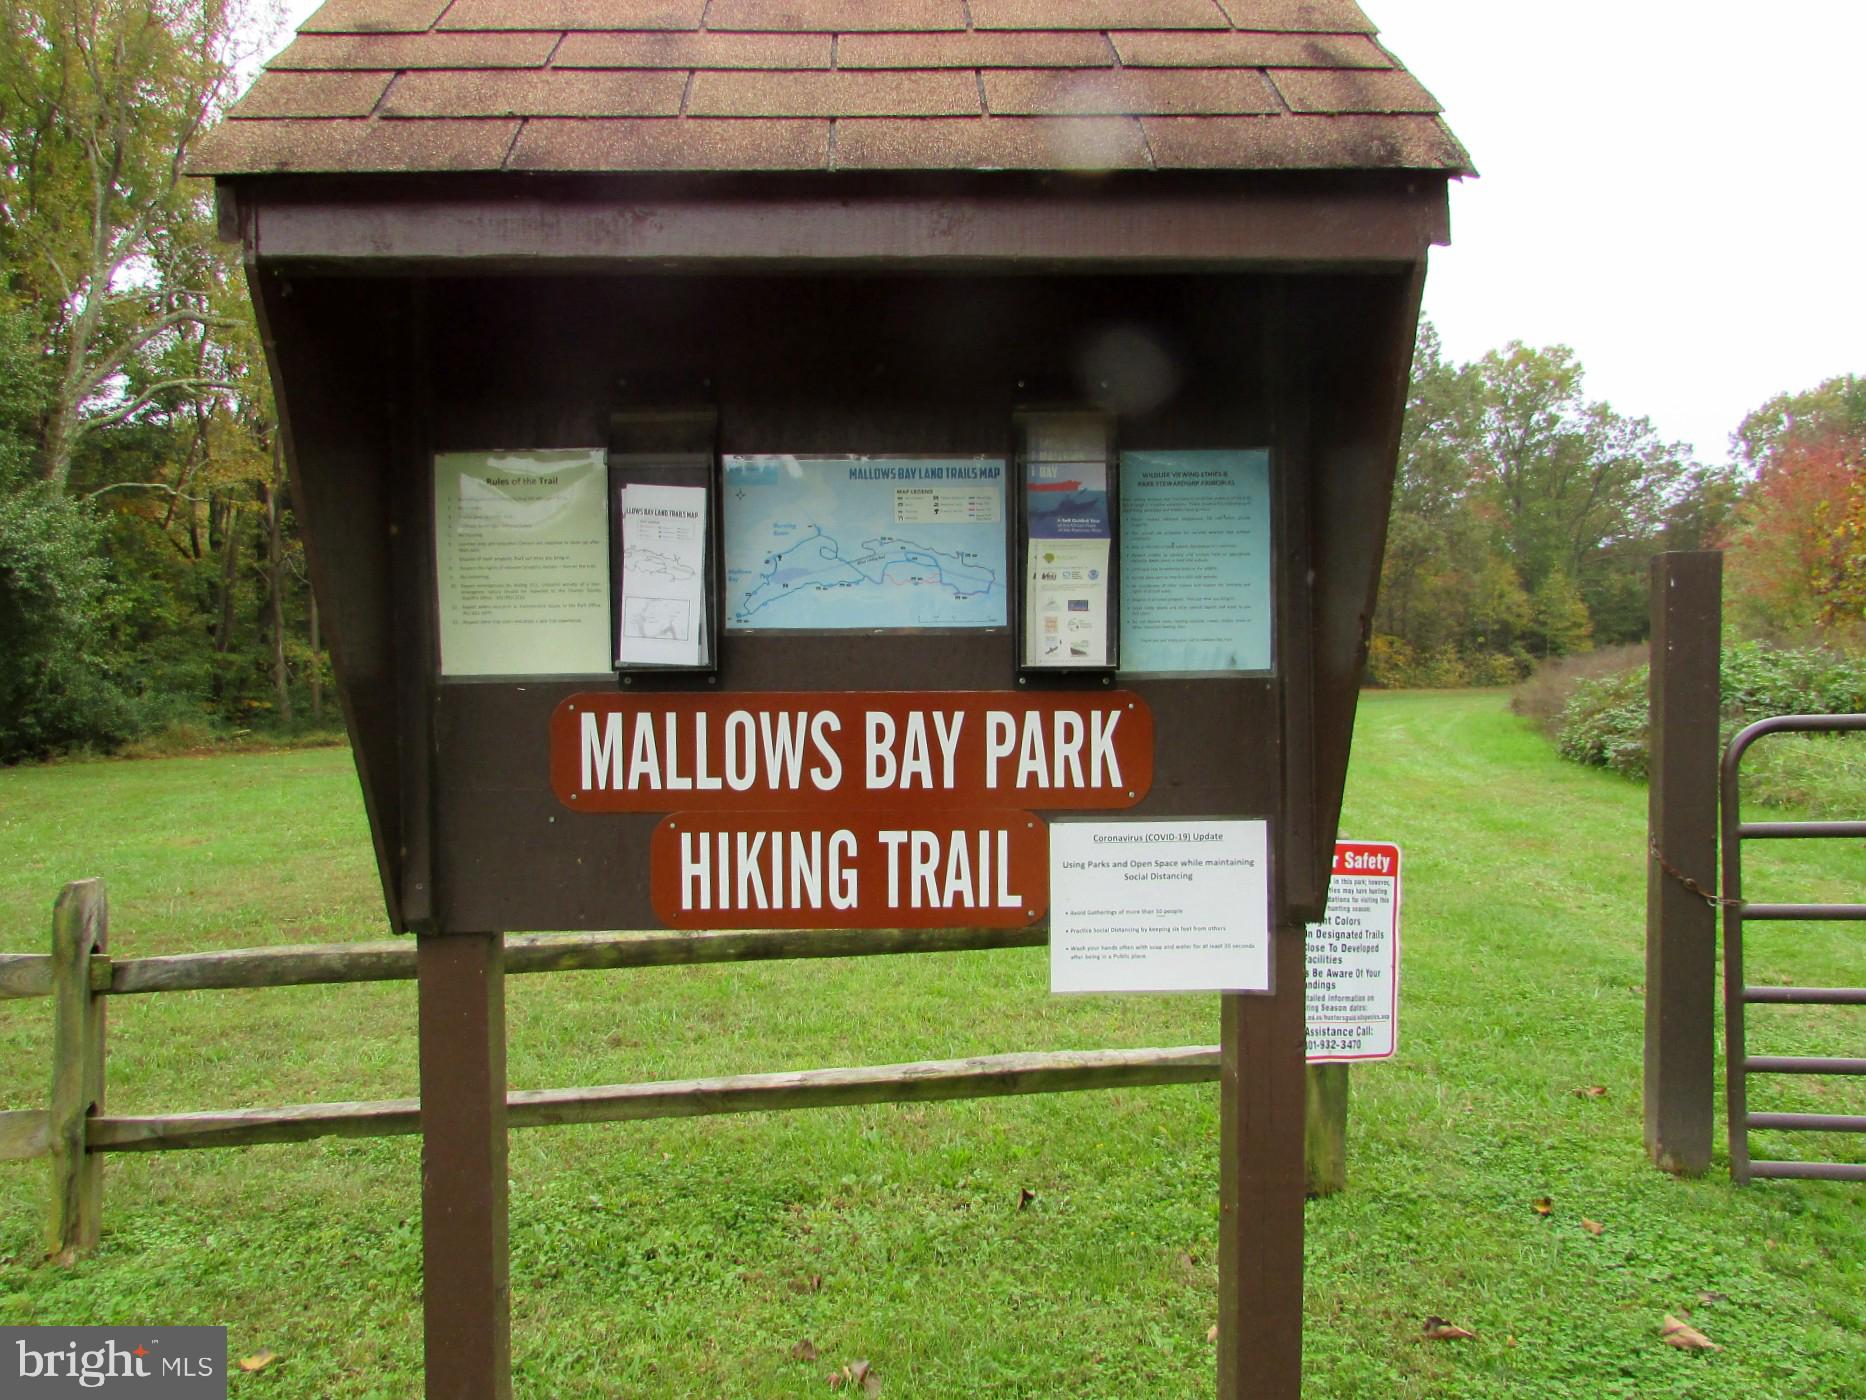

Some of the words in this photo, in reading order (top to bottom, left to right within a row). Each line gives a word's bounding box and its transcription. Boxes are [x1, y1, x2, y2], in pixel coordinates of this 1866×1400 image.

[850, 467, 896, 480] MALLOWS
[899, 467, 917, 480] BAY
[918, 467, 943, 480] LAND
[946, 467, 978, 480] TRAILS
[979, 466, 1000, 480] MAP
[486, 477, 510, 486] Rules
[512, 477, 521, 486] of
[522, 477, 537, 486] the
[539, 476, 558, 485] Trail
[580, 710, 843, 791] MALLOWS
[864, 710, 966, 789] BAY
[985, 710, 1122, 788] PARK
[1093, 834, 1143, 843] Coronavirus
[1145, 832, 1191, 843] (COVID-19)
[1193, 832, 1224, 842] Update
[1062, 861, 1086, 870] Using
[1088, 860, 1110, 869] Parks
[1111, 860, 1128, 868] and
[1130, 860, 1152, 870] Open
[1154, 859, 1178, 870] Space
[1180, 858, 1203, 868] while
[1204, 858, 1254, 868] maintaining
[1344, 852, 1390, 872] Safety
[680, 829, 858, 910] HIKING
[878, 829, 1022, 908] TRAIL
[1124, 872, 1148, 881] Social
[1150, 872, 1193, 882] Distancing
[1163, 908, 1183, 916] people
[1334, 916, 1361, 926] Colors
[1110, 926, 1140, 934] Distancing
[1140, 926, 1148, 934] by
[1148, 926, 1170, 934] keeping
[1316, 929, 1362, 940] Designated
[1365, 930, 1384, 940] Trails
[1329, 943, 1338, 952] To
[1342, 944, 1380, 954] Developed
[1306, 955, 1342, 964] acilities
[1312, 968, 1323, 978] Be
[1326, 968, 1353, 978] Aware
[1356, 968, 1364, 978] Of
[1366, 968, 1380, 978] Your
[1306, 982, 1336, 991] ndings
[1328, 994, 1366, 1002] information
[1321, 1004, 1347, 1012] Season
[1306, 1027, 1354, 1037] Assistance
[1356, 1026, 1374, 1036] Call:
